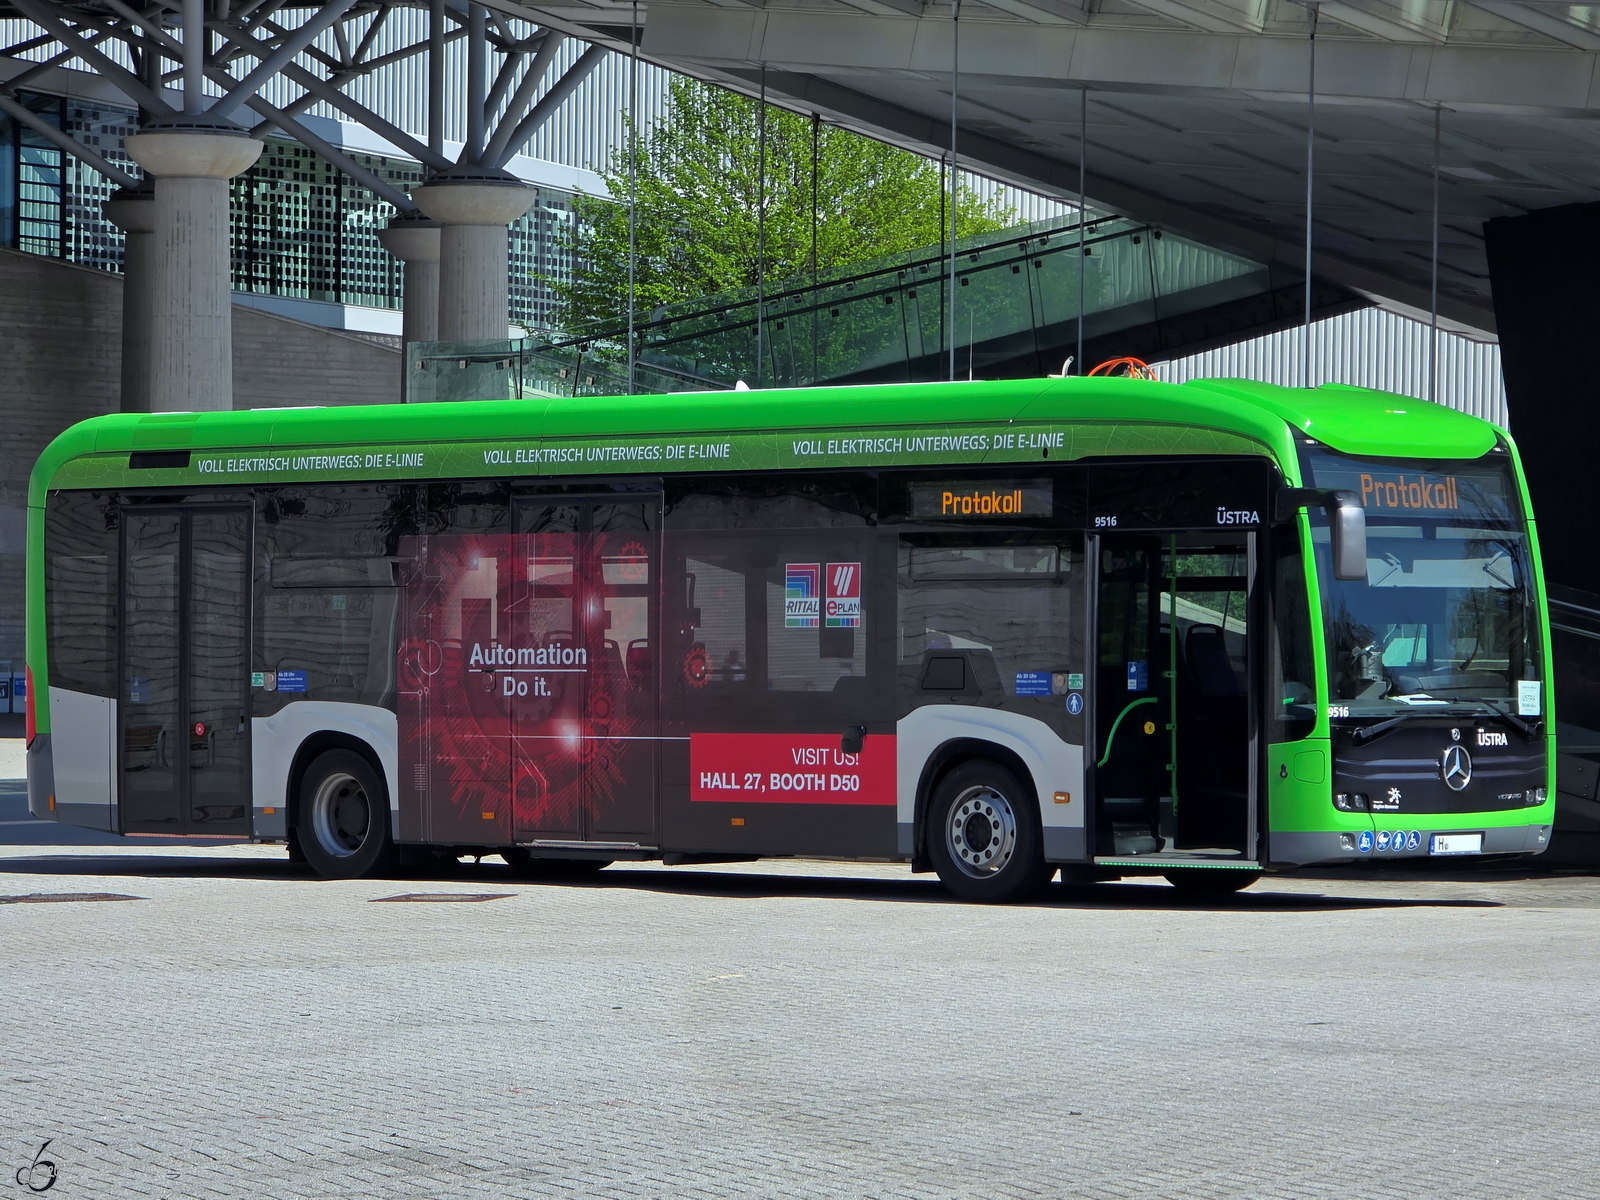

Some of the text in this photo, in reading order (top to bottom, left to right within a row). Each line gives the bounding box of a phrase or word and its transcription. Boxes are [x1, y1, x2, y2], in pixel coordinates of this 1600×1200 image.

[483, 443, 731, 464] VOLL ELEKTRISCH UNTERWEGS: DIE E-LINIE
[793, 432, 1064, 455] VOLL ELEKTRISCH UNTERWEGS: DIE E-LINIE
[198, 453, 424, 473] VOLL ELEKTRISCH UNTERWEGS: DIE E-LINIE
[1360, 474, 1458, 510] Protokoll
[942, 490, 1023, 515] Protokoll
[1095, 516, 1117, 527] 9516
[1217, 506, 1260, 524] ÜSTRA
[786, 600, 819, 613] RITTAL
[469, 642, 587, 665] Automation
[503, 676, 552, 697] Do it.
[1328, 706, 1349, 718] 9516
[1478, 728, 1508, 746] ÜSTRA
[792, 748, 829, 765] VISIT
[700, 772, 860, 793] HALL 27, BOOTH D50
